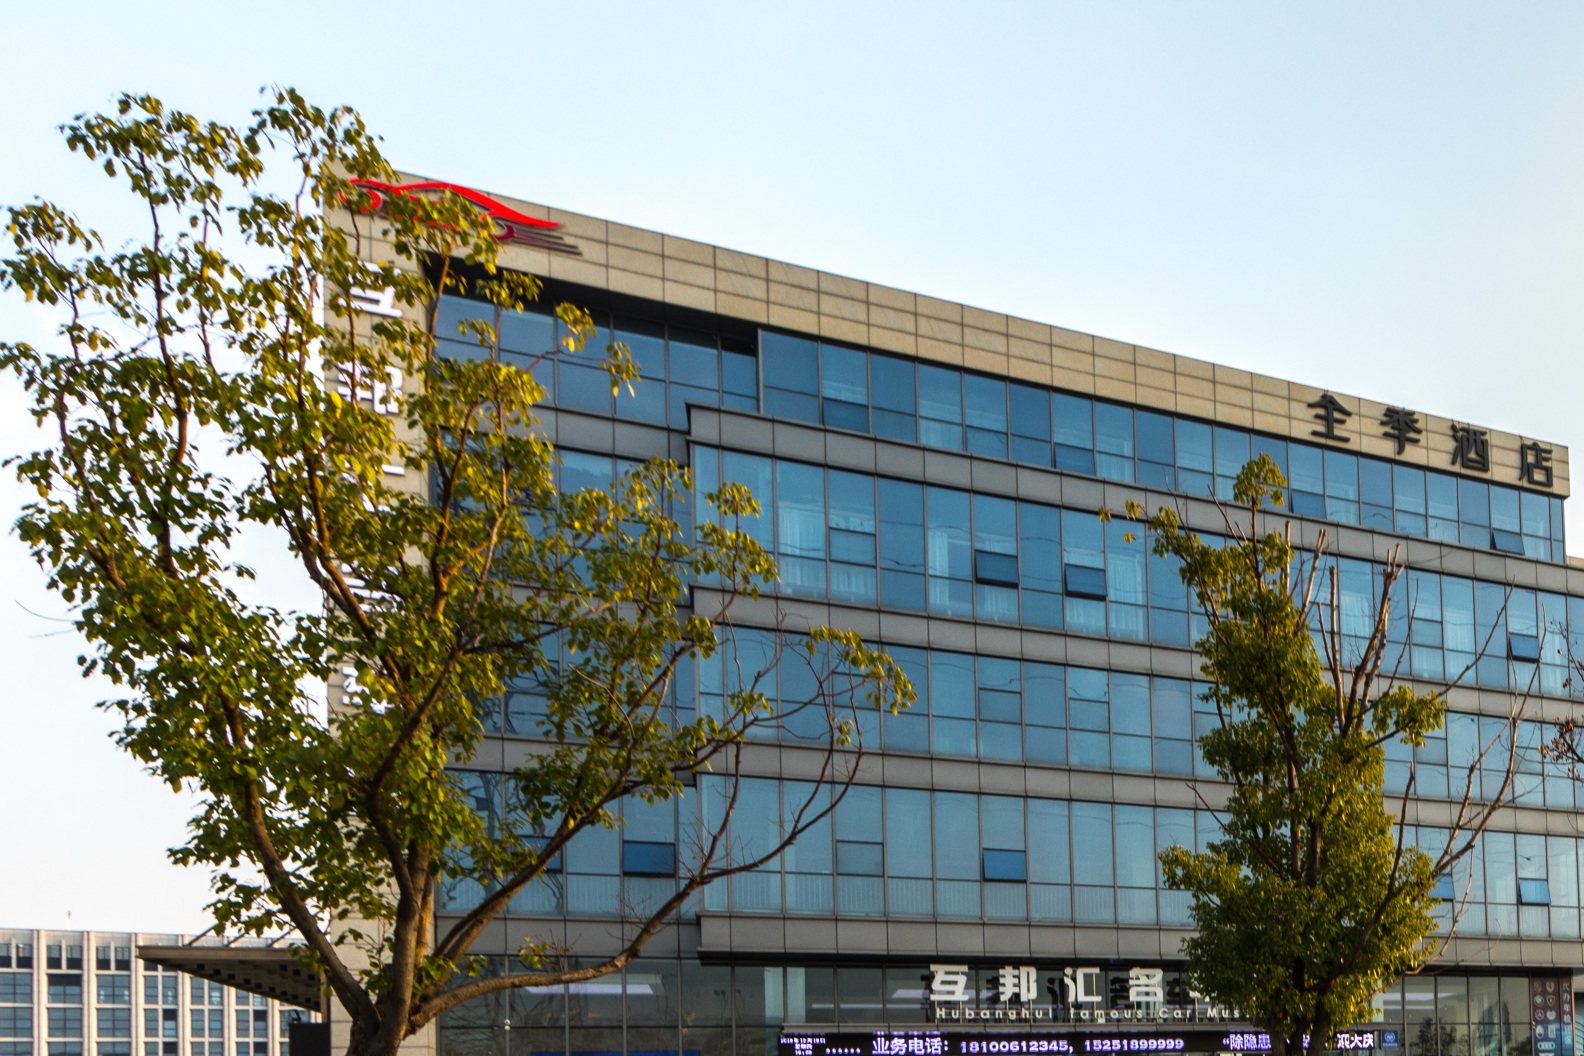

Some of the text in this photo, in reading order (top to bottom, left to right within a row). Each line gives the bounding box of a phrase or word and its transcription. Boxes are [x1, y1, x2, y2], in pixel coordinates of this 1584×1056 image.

[1308, 393, 1553, 487] 全季酒店
[930, 963, 1216, 1003] 互邦汇名
[1159, 1007, 1192, 1019] Car
